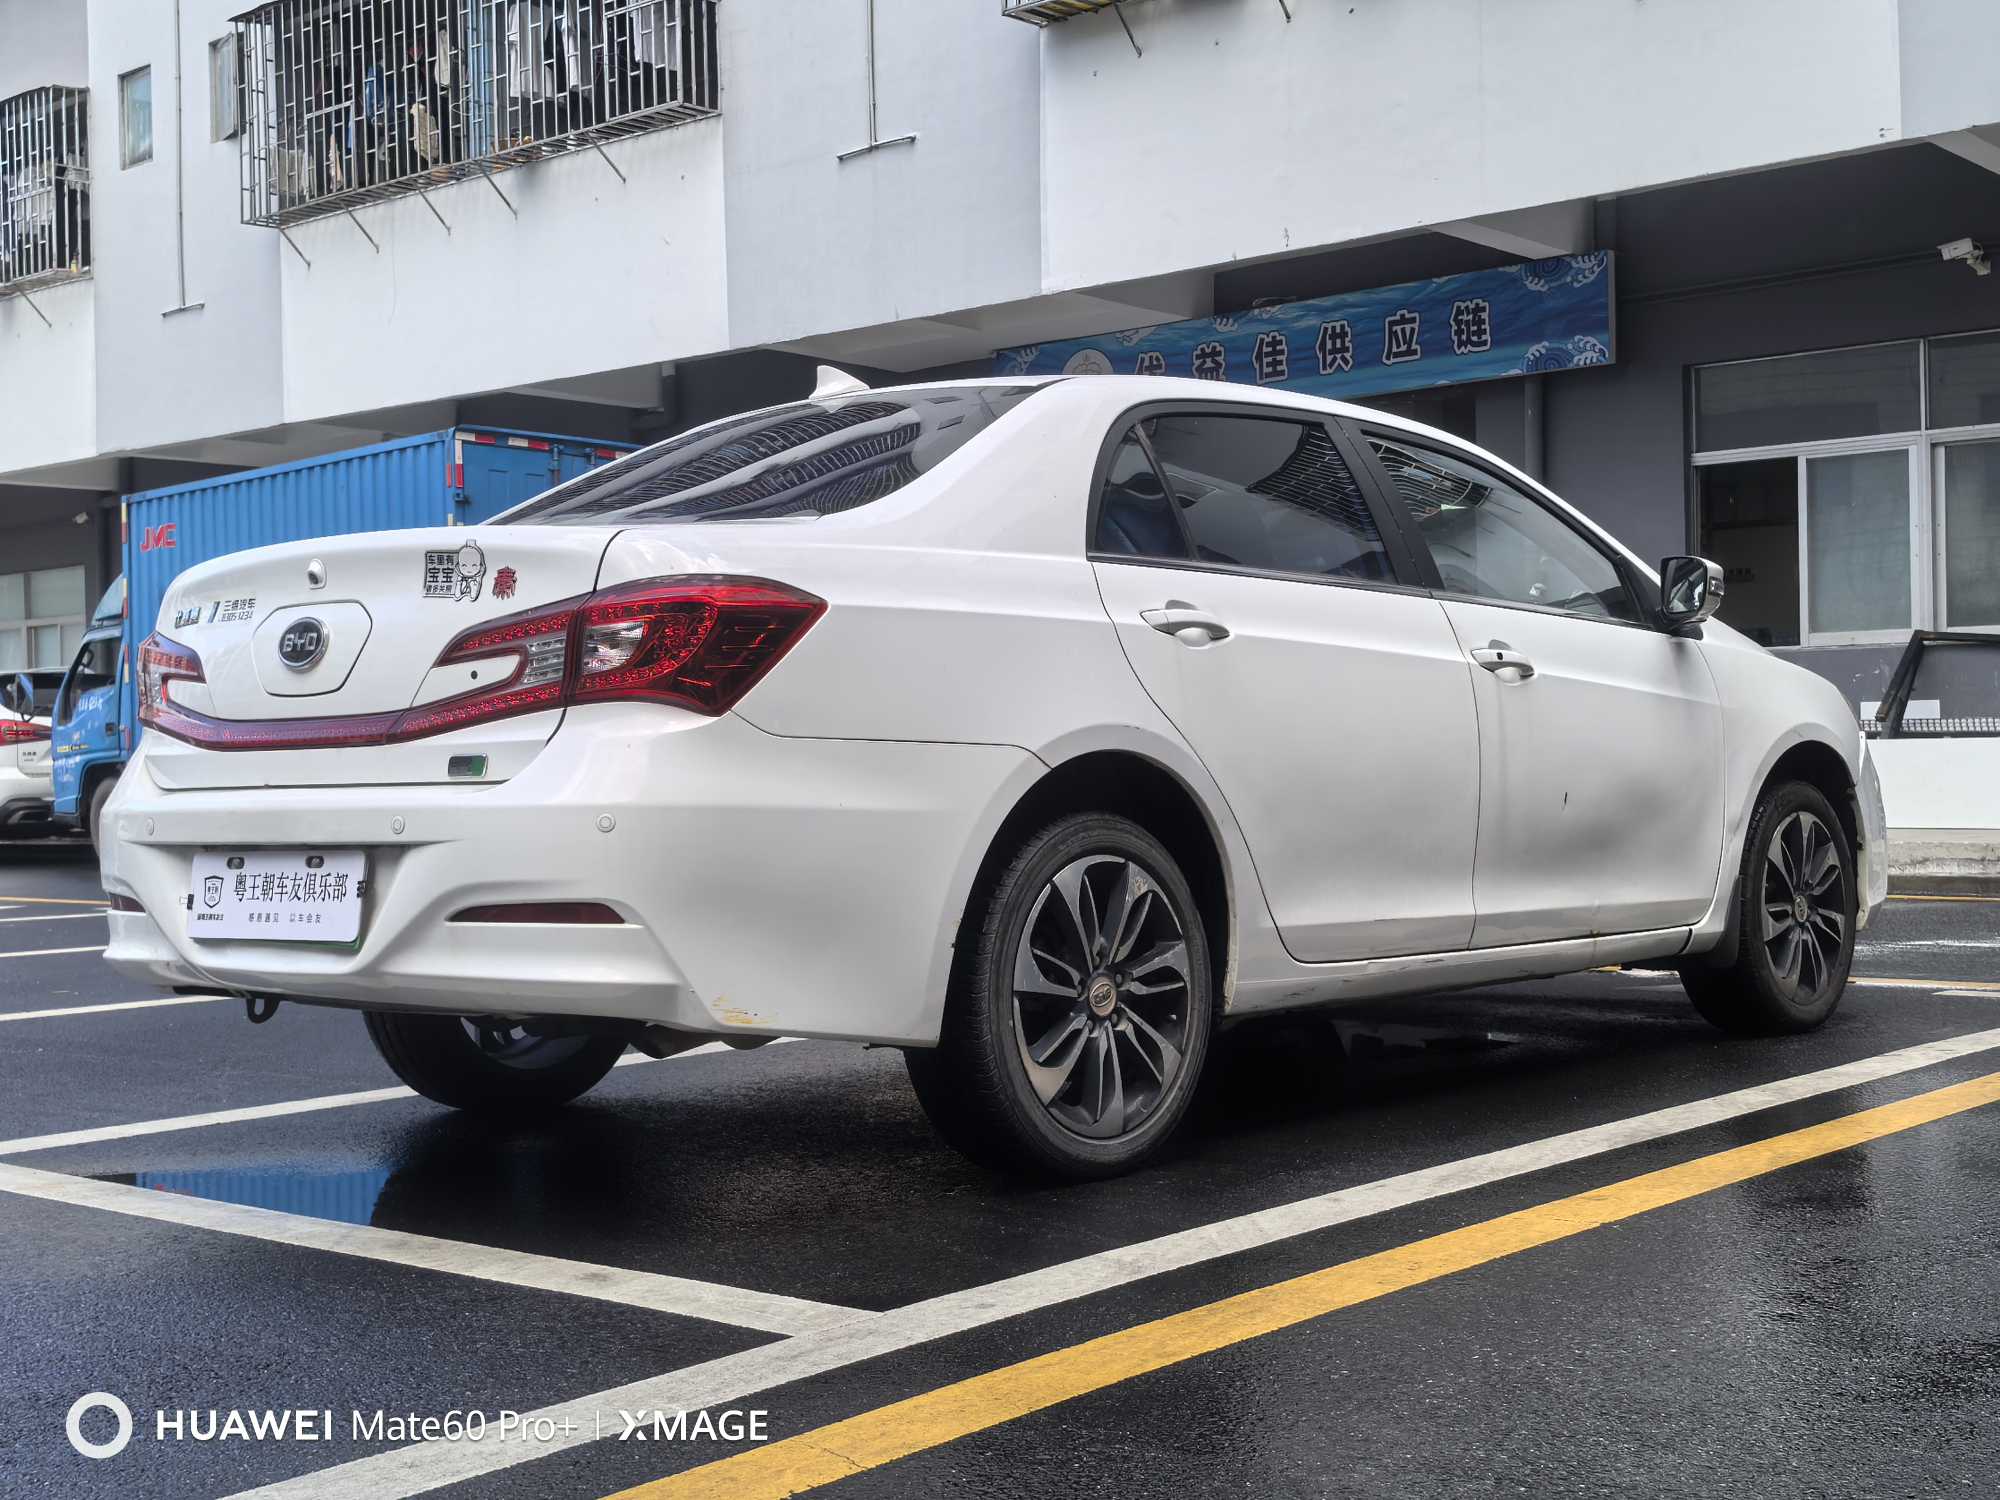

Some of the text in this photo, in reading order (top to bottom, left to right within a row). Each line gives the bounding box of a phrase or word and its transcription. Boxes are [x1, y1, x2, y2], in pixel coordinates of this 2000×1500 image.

[140, 523, 177, 552] JMC
[427, 566, 455, 583] 宝宝
[283, 631, 318, 652] BYD
[233, 871, 348, 903] 粤王朝车友俱乐部
